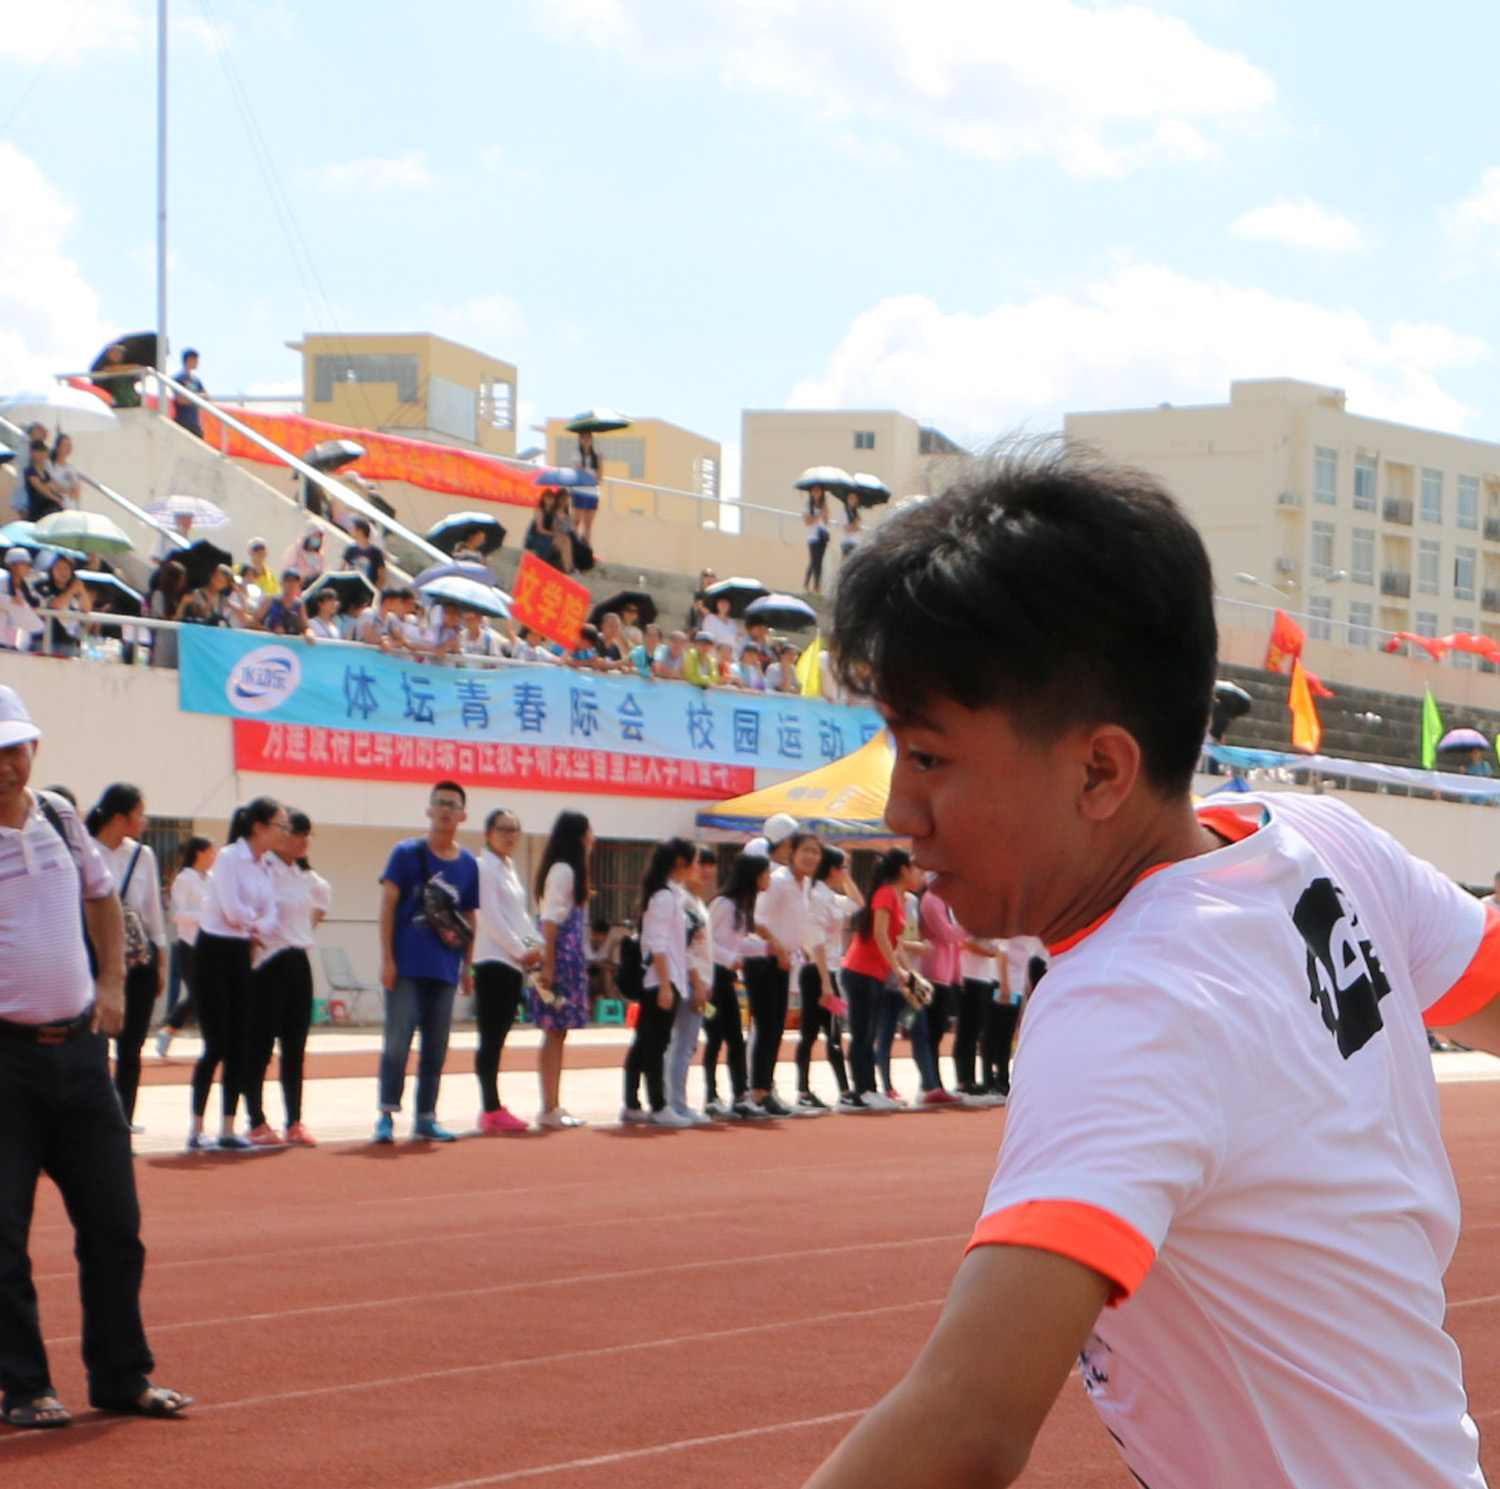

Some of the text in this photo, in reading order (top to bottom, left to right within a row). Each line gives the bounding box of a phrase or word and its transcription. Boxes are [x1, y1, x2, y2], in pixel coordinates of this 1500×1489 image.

[515, 566, 584, 641] 文学院
[343, 663, 646, 742] 体坛青春际会
